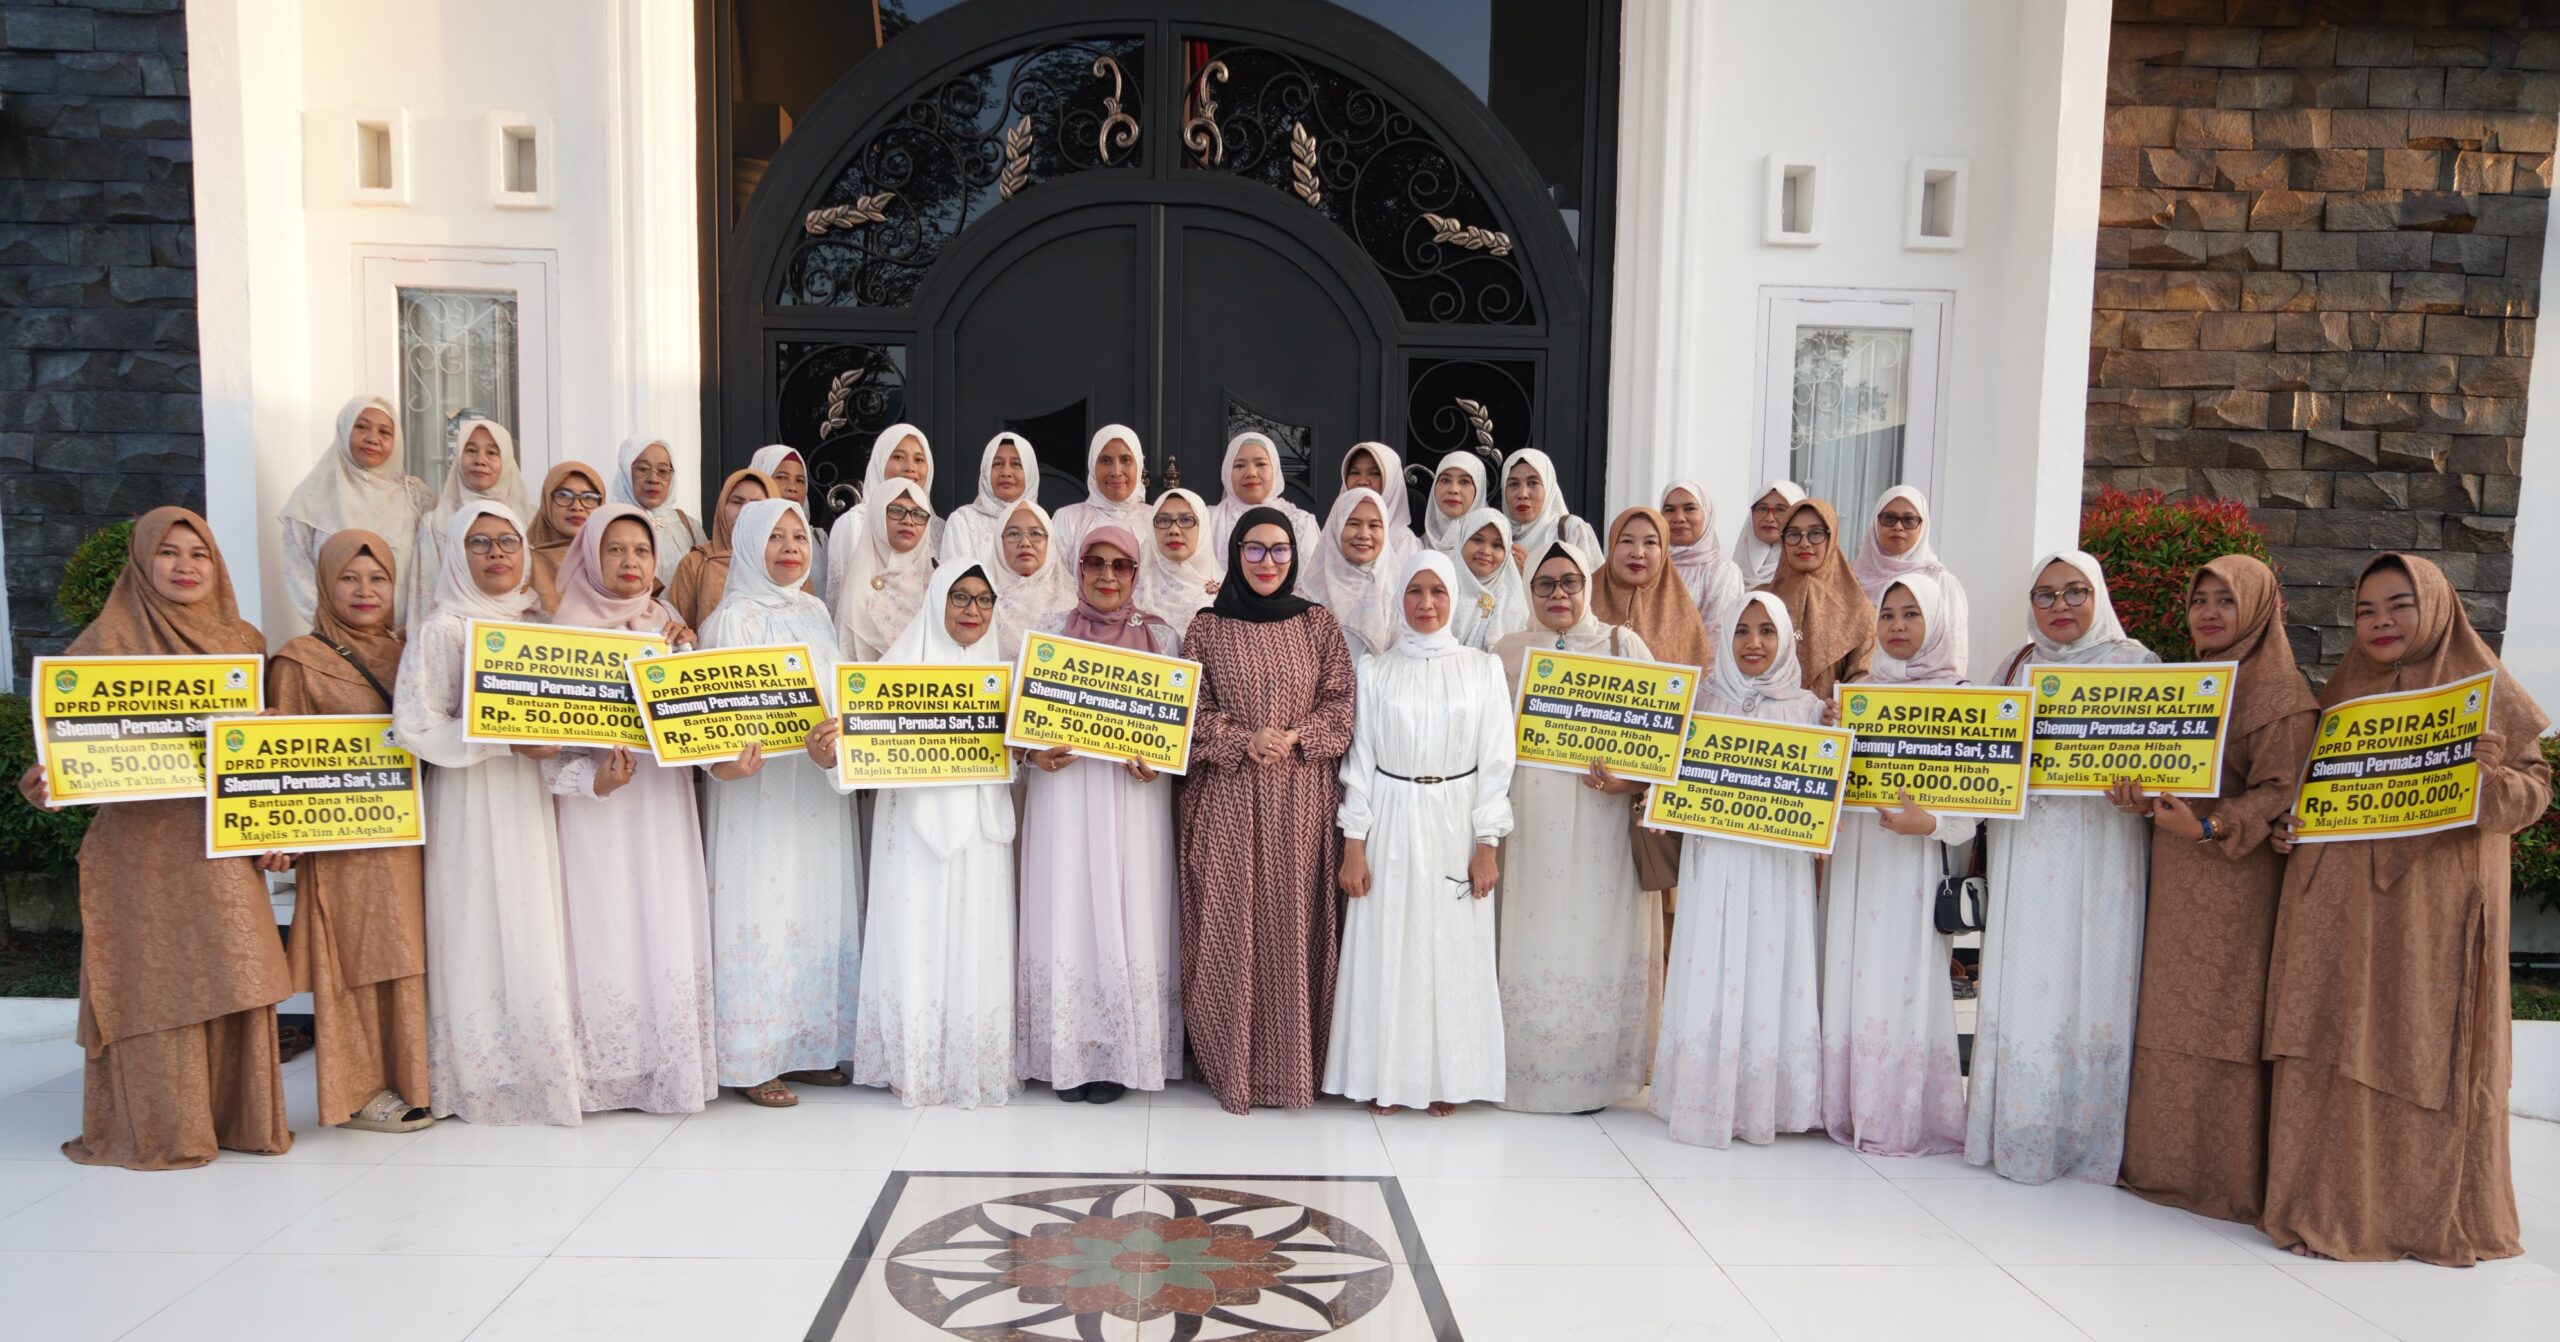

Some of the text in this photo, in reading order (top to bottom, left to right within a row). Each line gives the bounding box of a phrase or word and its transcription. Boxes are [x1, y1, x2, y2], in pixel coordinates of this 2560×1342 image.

[485, 660, 599, 678] DPRD PROVINSI
[680, 664, 777, 684] ASPIRASI
[1063, 658, 1160, 687] ASPIRASI
[92, 679, 215, 697] ASPIRASI
[483, 676, 628, 701] Shemmy Permata Sari,
[653, 677, 807, 699] DPRD PROVINSI KALTIM
[877, 683, 973, 698] ASPIRASI
[1033, 667, 1184, 703] DPRD PROVINSI KALTIM
[1560, 671, 1656, 695] ASPIRASI
[656, 692, 812, 716] Shemmy Permata Sari, S.H.
[1030, 682, 1180, 721] Shemmy Permata Sari, S.H.
[1533, 684, 1680, 711] DPRD PROVINSI KALTIM
[2071, 686, 2185, 702] ASPIRASI
[55, 698, 247, 713] DPRD PROVINSI KALTIM
[482, 706, 515, 723] Rp.
[507, 697, 635, 714] Bantuan Dana Hibah
[849, 700, 999, 710] DPRD PROVINSI KALTIM
[1529, 698, 1674, 730] Shemmy Permata Sari, S.H.
[1877, 706, 1986, 724] ASPIRASI
[2038, 704, 2214, 715] DPRD PROVINSI KALTIM
[684, 711, 797, 727] Bantuan Dana Hibah
[850, 716, 998, 733] Shemmy Permata Sari, S.H.
[1047, 704, 1158, 731] Bantuan Dana Hibah
[2346, 707, 2455, 738] ASPIRASI
[56, 720, 119, 738] Shemmy
[121, 719, 183, 734] Permata
[480, 723, 617, 738] Majelis Muslimah
[664, 731, 697, 746] Rp.
[1023, 710, 1177, 752] Rp. 50.000.000,-
[1545, 720, 1651, 741] Bantuan Dana Hibah
[1888, 724, 2016, 738] PROVINSI KALTIM
[2036, 720, 2209, 738] Shemmy Permata Sari, S.H.
[2318, 721, 2477, 756] DPRD PROVINSI KALTIM
[258, 738, 371, 755] ASPIRASI
[679, 739, 792, 755] Majelis Nurul
[920, 737, 945, 745] Dana
[1024, 727, 1064, 740] Majelis
[1103, 741, 1171, 761] Al-Khasanah
[1523, 728, 1670, 762] Rp. 50.000.000,-
[1705, 734, 1807, 760] ASPIRASI
[1898, 741, 2014, 759] Permata Sari, S.H.
[2055, 742, 2181, 751] Bantuan Dana Hibah
[226, 755, 404, 770] DPRD PROVINSI KALTIM
[851, 747, 1000, 766] Rp. 50.000.000,-
[1714, 752, 1833, 776] PROVINSI KALTIM
[2069, 753, 2205, 774] 50.000.000,-
[2313, 748, 2450, 777] Shemmy Permata Sari,
[62, 758, 100, 777] Rp.
[854, 766, 892, 777] Majelis
[952, 765, 998, 773] Muslimat
[1866, 761, 1989, 774] Bantuan Dana Hibah
[225, 773, 405, 794] Shemmy Permata Sari, S.H.
[1720, 768, 1828, 796] Permata Sari, S.H.
[1880, 773, 2012, 796] 50.000.000,-
[2047, 772, 2181, 784] Majelis An-Nur
[2331, 771, 2453, 792] Bantuan Dana Hibah
[249, 795, 383, 808] Bantuan Dana Hibah
[1687, 784, 1804, 808] Bantuan Dana Hibah
[2305, 782, 2470, 817] Rp. 50.000.000,-
[225, 806, 409, 830] Rp. 50.000.000,-
[1662, 791, 1824, 830] Rp. 50.000.000,-
[2315, 817, 2358, 829] Majelis
[2403, 806, 2456, 821] Al-Kharim
[241, 831, 288, 842] Majelis
[337, 826, 393, 837] Al-Aqsha
[1667, 810, 1706, 823] Majelis
[1747, 822, 1813, 839] Al-Madinah
